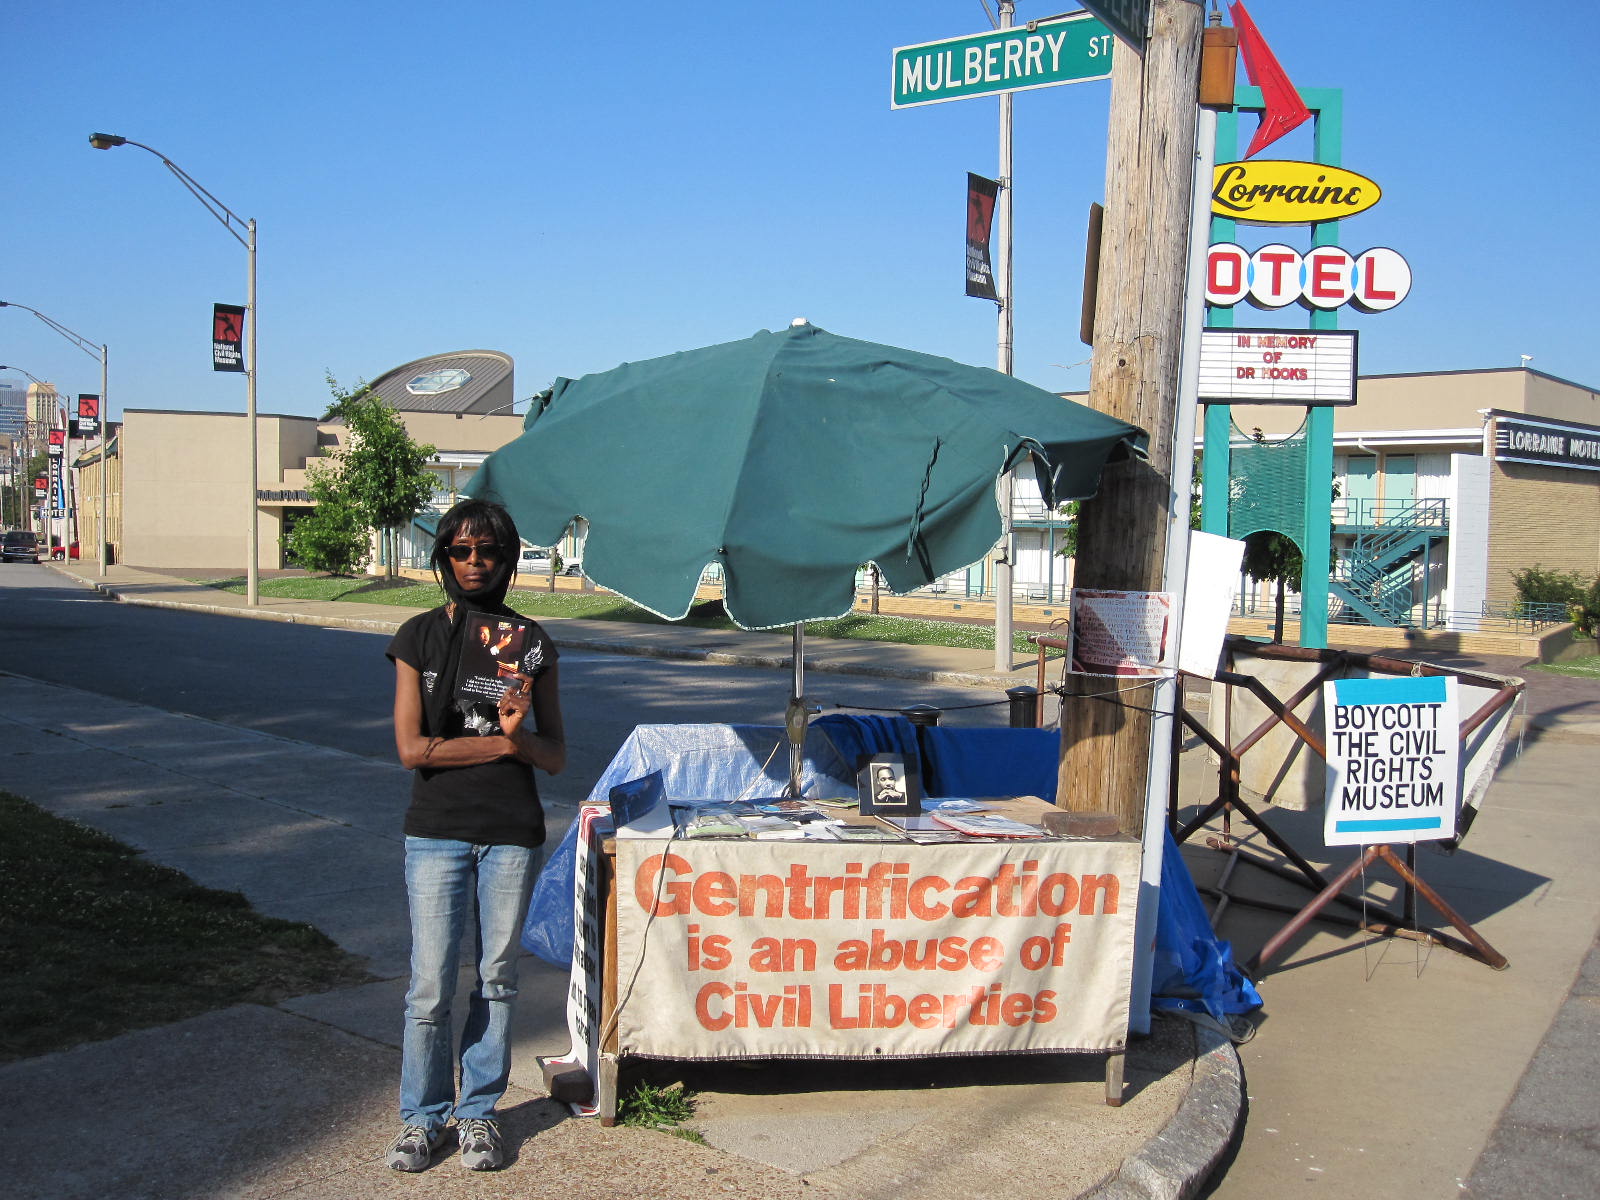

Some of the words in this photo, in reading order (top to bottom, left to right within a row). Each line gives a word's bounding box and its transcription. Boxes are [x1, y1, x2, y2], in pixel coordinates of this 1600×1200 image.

[902, 31, 1067, 95] MULBERRY
[1088, 35, 1110, 58] ST
[1212, 165, 1362, 211] Lorraine
[1208, 252, 1396, 300] OTEL
[1237, 335, 1250, 348] IN
[1257, 335, 1317, 348] MEMORY
[1263, 351, 1283, 363] OF
[1237, 367, 1255, 379] DR
[1261, 367, 1308, 380] HOOKS
[1509, 429, 1564, 455] LORRAINE
[1334, 703, 1442, 730] BOYCOTT
[1332, 731, 1379, 758] THE
[1389, 730, 1446, 756] CIVIL
[1346, 756, 1434, 784] RIGHTS
[1341, 782, 1444, 811] MUSEUM
[634, 852, 1120, 921] Gentrification
[687, 924, 732, 972] is
[748, 936, 817, 972] an
[833, 928, 1004, 972] abuse
[1019, 923, 1071, 972] of
[695, 981, 812, 1032] Civil
[829, 983, 1058, 1030] Liberties
